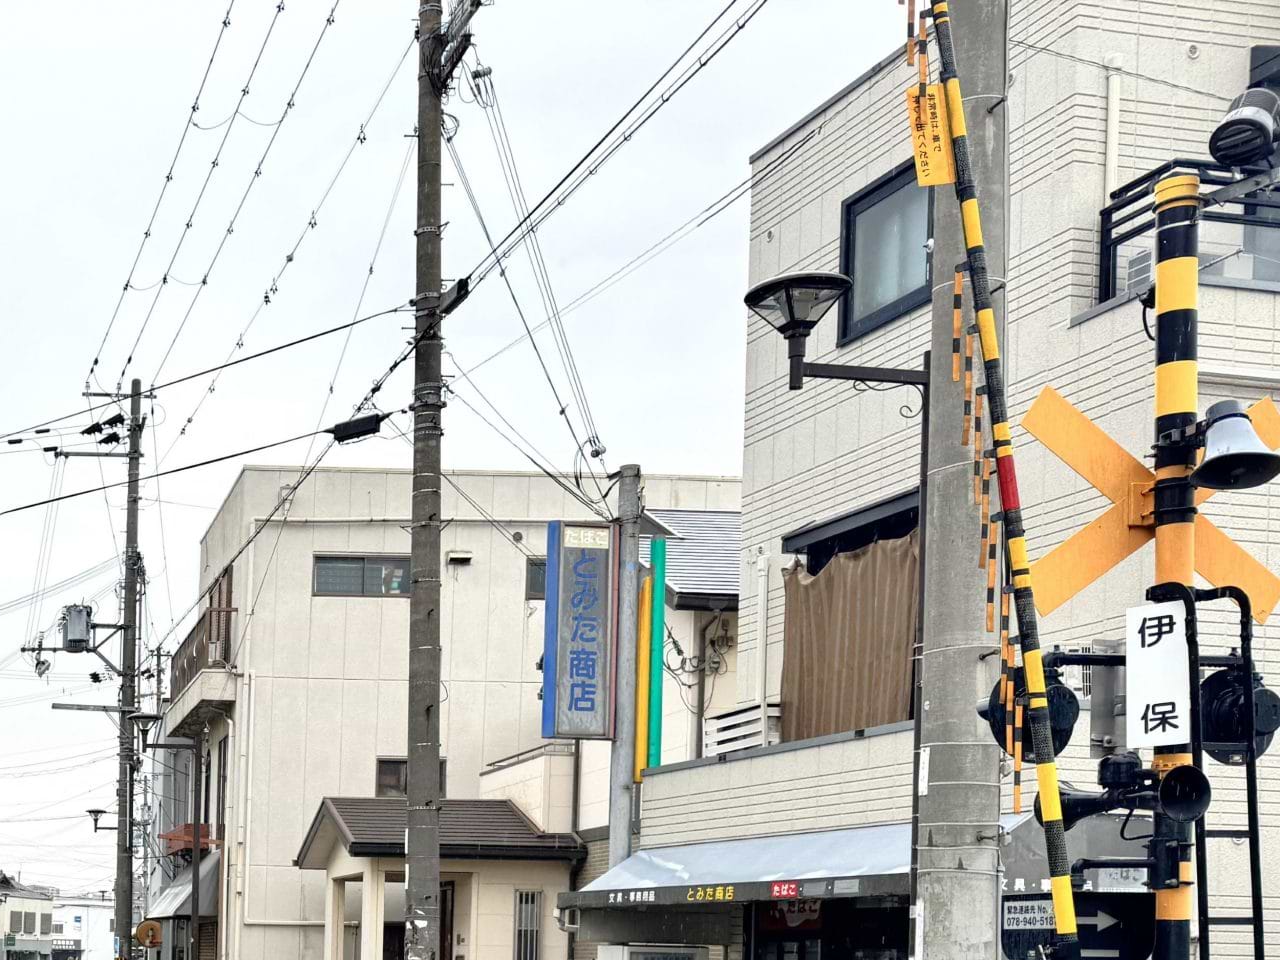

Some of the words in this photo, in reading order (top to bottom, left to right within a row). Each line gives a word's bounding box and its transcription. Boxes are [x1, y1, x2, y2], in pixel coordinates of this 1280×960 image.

[565, 529, 609, 547] たばこ
[567, 548, 599, 712] とみた商店
[1137, 614, 1180, 734] 伊保
[686, 885, 735, 901] とみた商店
[773, 883, 797, 896] たばこ
[1007, 916, 1058, 927] 078-940-518
